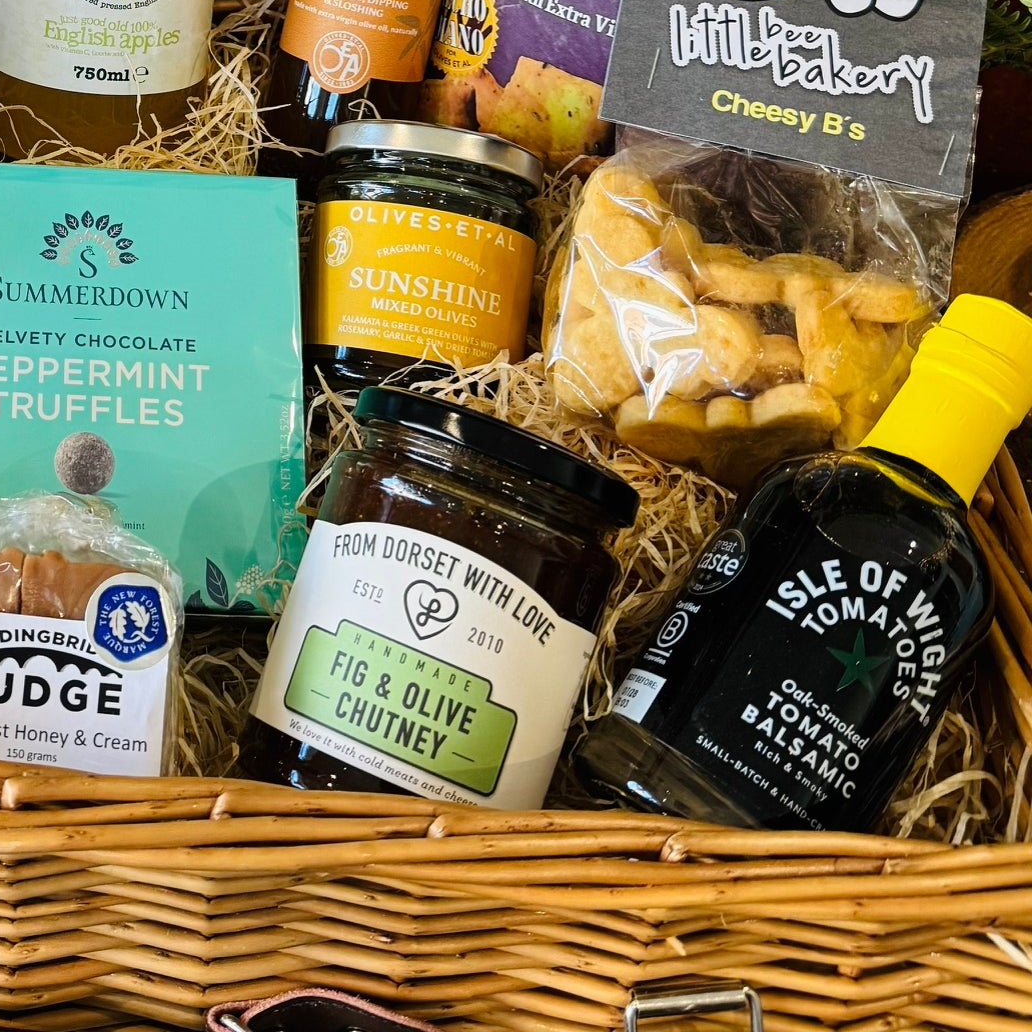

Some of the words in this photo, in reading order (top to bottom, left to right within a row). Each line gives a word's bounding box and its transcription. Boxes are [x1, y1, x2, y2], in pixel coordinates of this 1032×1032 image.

[100, 2, 132, 10] pressed
[764, 11, 822, 43] bee
[43, 19, 115, 47] English
[119, 27, 181, 55] apples
[674, 8, 771, 64] little
[74, 65, 129, 81] 750ml
[777, 34, 929, 120] bakery
[711, 89, 816, 134] Cheesy
[348, 266, 501, 316] SUNSHINE
[371, 297, 422, 316] MIXED
[425, 305, 477, 329] OLIVES
[74, 333, 197, 353] CHOCOLATE
[99, 603, 112, 626] THE
[112, 590, 136, 603] NEW
[140, 594, 160, 635] FOREST
[333, 533, 377, 558] FROM
[382, 535, 461, 580] DORSET
[463, 563, 514, 609] WITH
[511, 596, 556, 646] LOVE
[102, 632, 147, 654] MARQUE
[353, 632, 472, 693] HANDMADE
[467, 627, 505, 654] 2010
[765, 558, 848, 621] ISLE
[859, 560, 908, 600] OF
[906, 589, 946, 723] WIGHT
[800, 596, 917, 700] TOMATOES
[329, 649, 369, 688] FIG
[374, 672, 392, 701] &
[401, 682, 478, 736] OLIVE
[781, 679, 870, 751] Oak-Smoked
[14, 724, 68, 748] Honey
[74, 729, 86, 746] &
[93, 733, 148, 753] Cream
[334, 691, 448, 761] CHUTNEY
[766, 690, 860, 771] TOMATO
[7, 748, 25, 759] 150
[27, 752, 57, 763] grams
[740, 703, 856, 799] BALSAMIC
